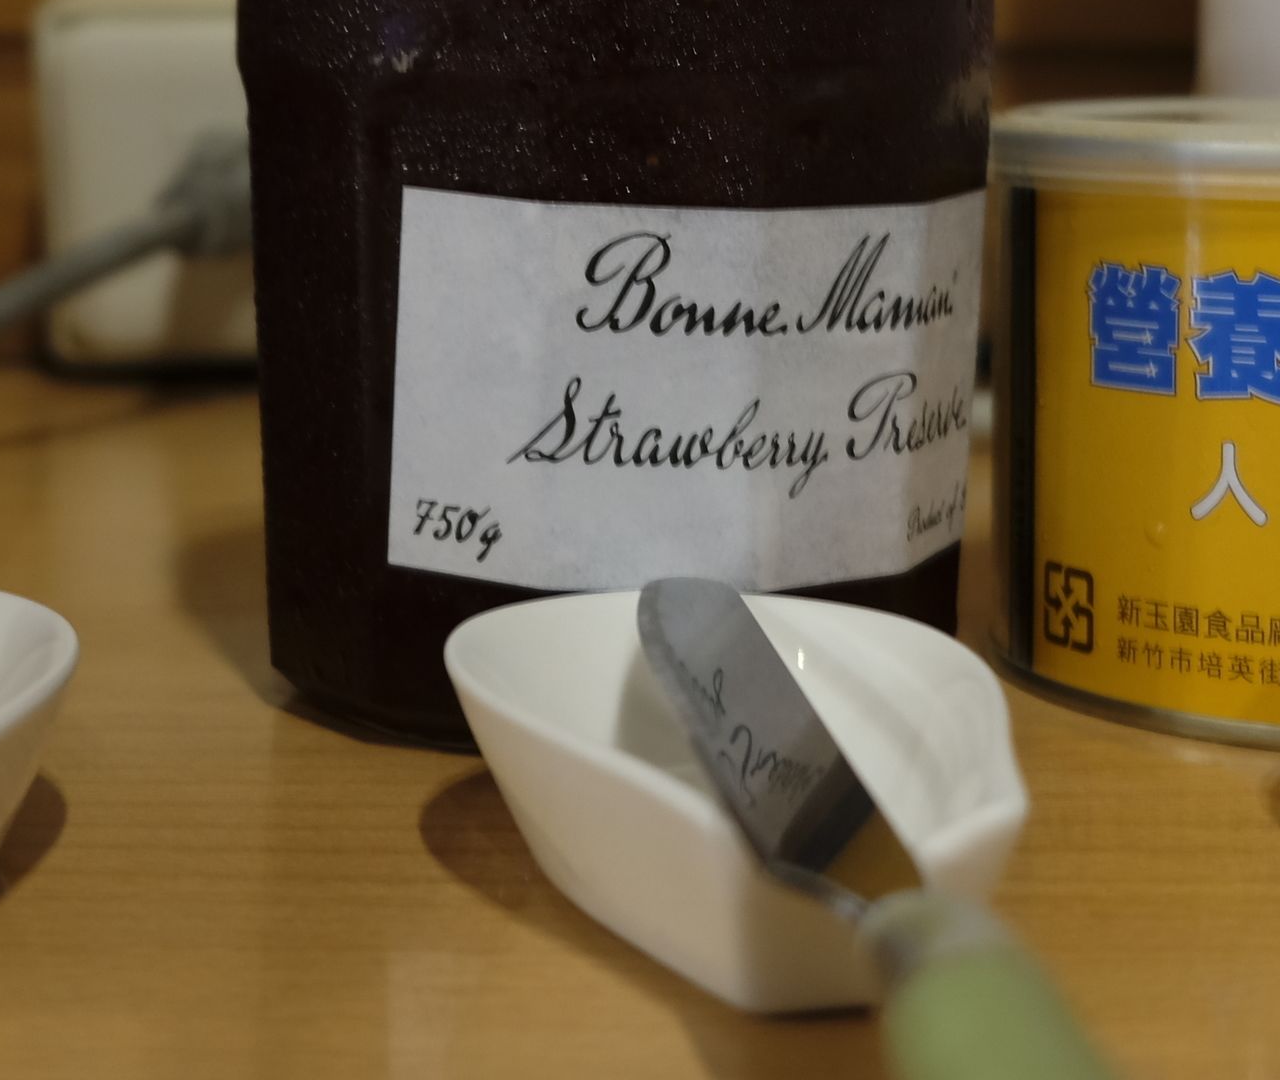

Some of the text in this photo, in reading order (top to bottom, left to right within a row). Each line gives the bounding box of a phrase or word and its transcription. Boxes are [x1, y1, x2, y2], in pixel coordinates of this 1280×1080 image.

[576, 232, 788, 334] Bonne
[507, 377, 828, 498] Strawberry
[413, 498, 503, 562] 750g
